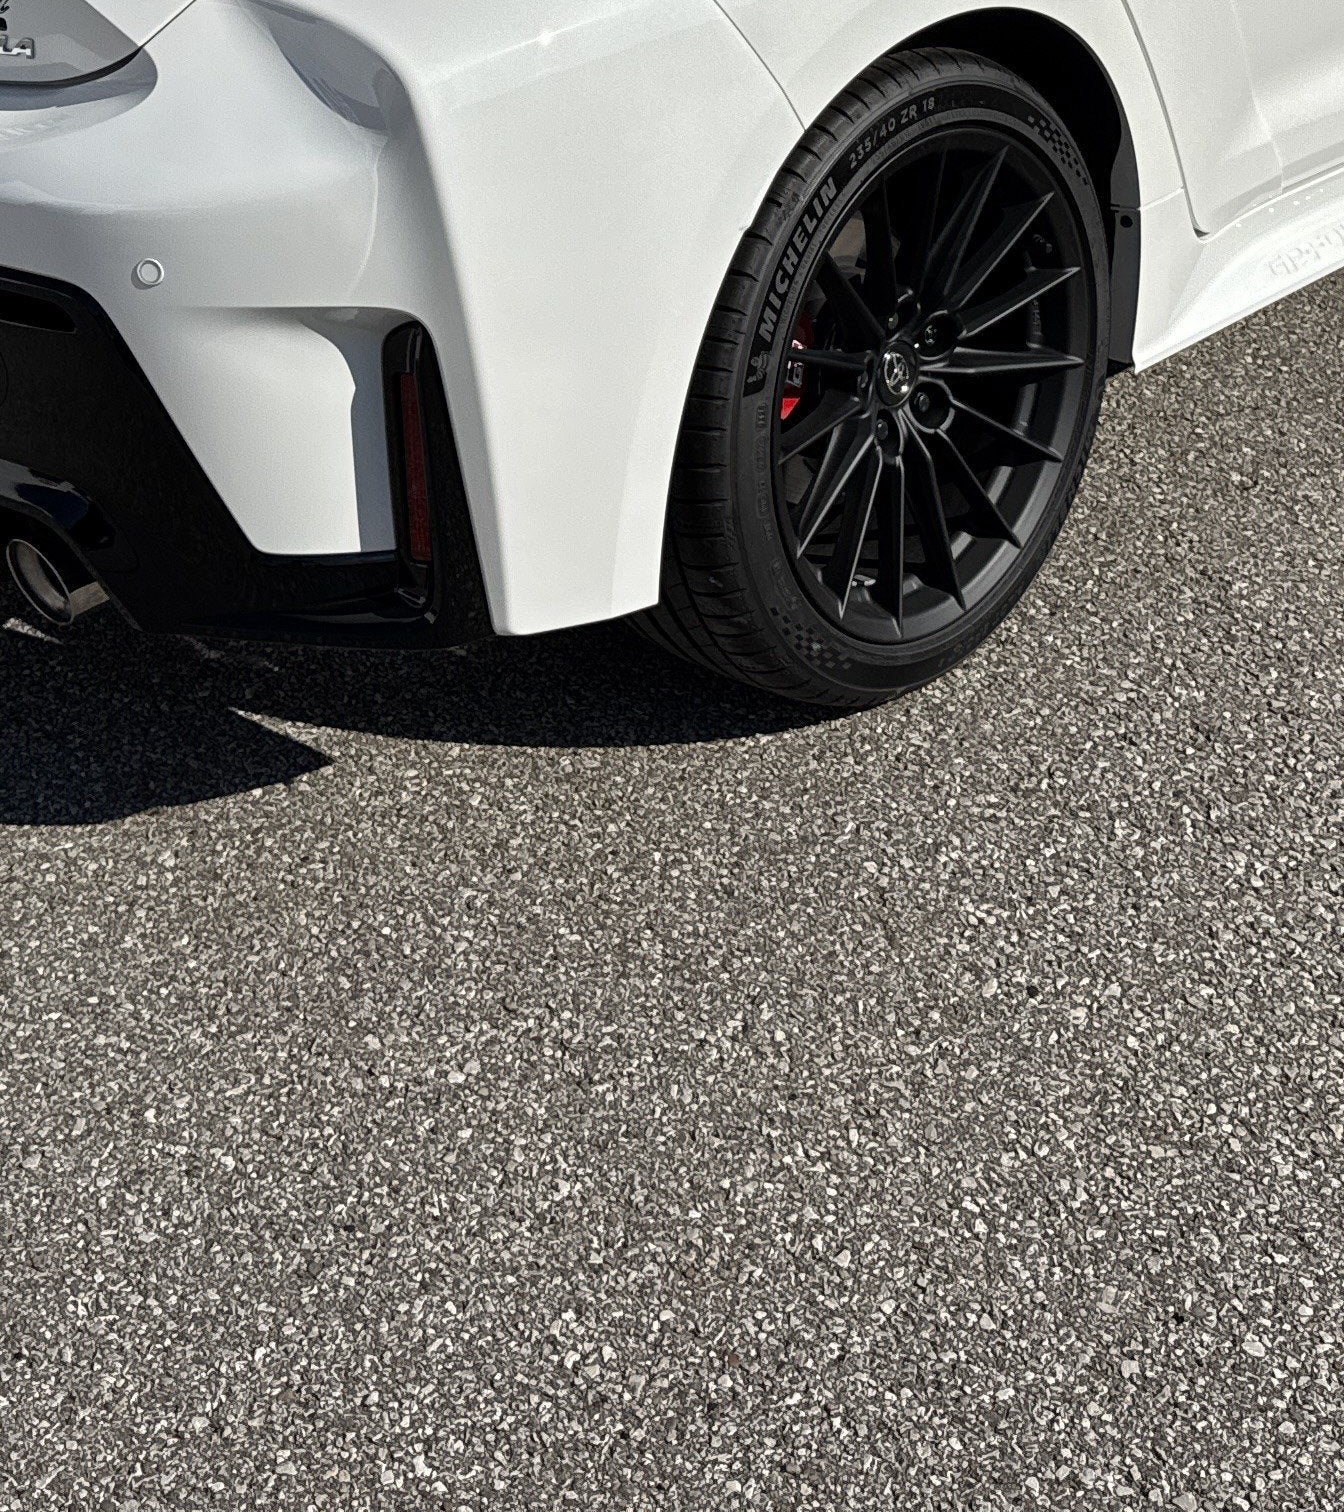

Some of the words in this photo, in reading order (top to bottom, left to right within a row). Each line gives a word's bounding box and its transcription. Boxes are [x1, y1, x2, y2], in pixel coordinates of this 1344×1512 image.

[758, 176, 838, 344] MICHELIN
[848, 117, 896, 170] 235/40
[900, 106, 918, 125] ZR
